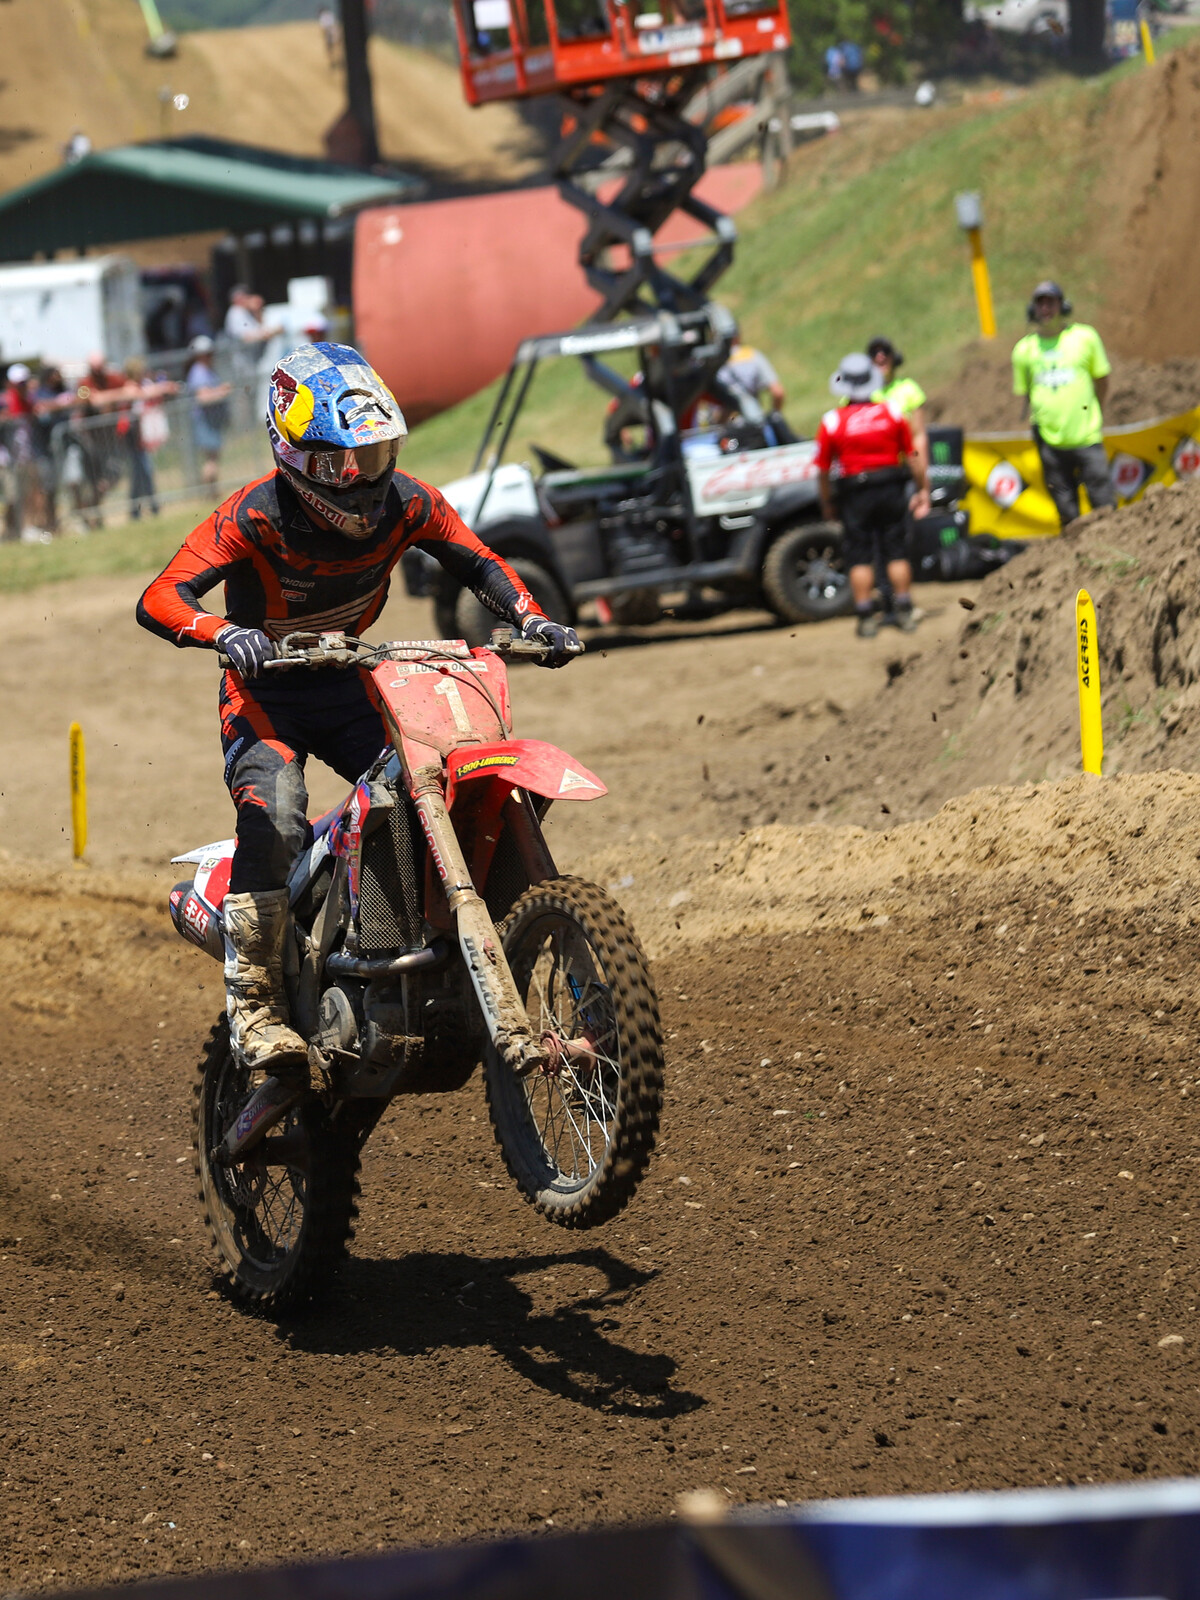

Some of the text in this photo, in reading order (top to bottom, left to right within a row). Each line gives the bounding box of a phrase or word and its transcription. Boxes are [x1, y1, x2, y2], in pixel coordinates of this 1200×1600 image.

[279, 576, 316, 588] SHOWA
[1080, 618, 1090, 689] ACERBIS
[433, 677, 473, 732] 1
[456, 756, 519, 777] 1-800-LAWRENCE
